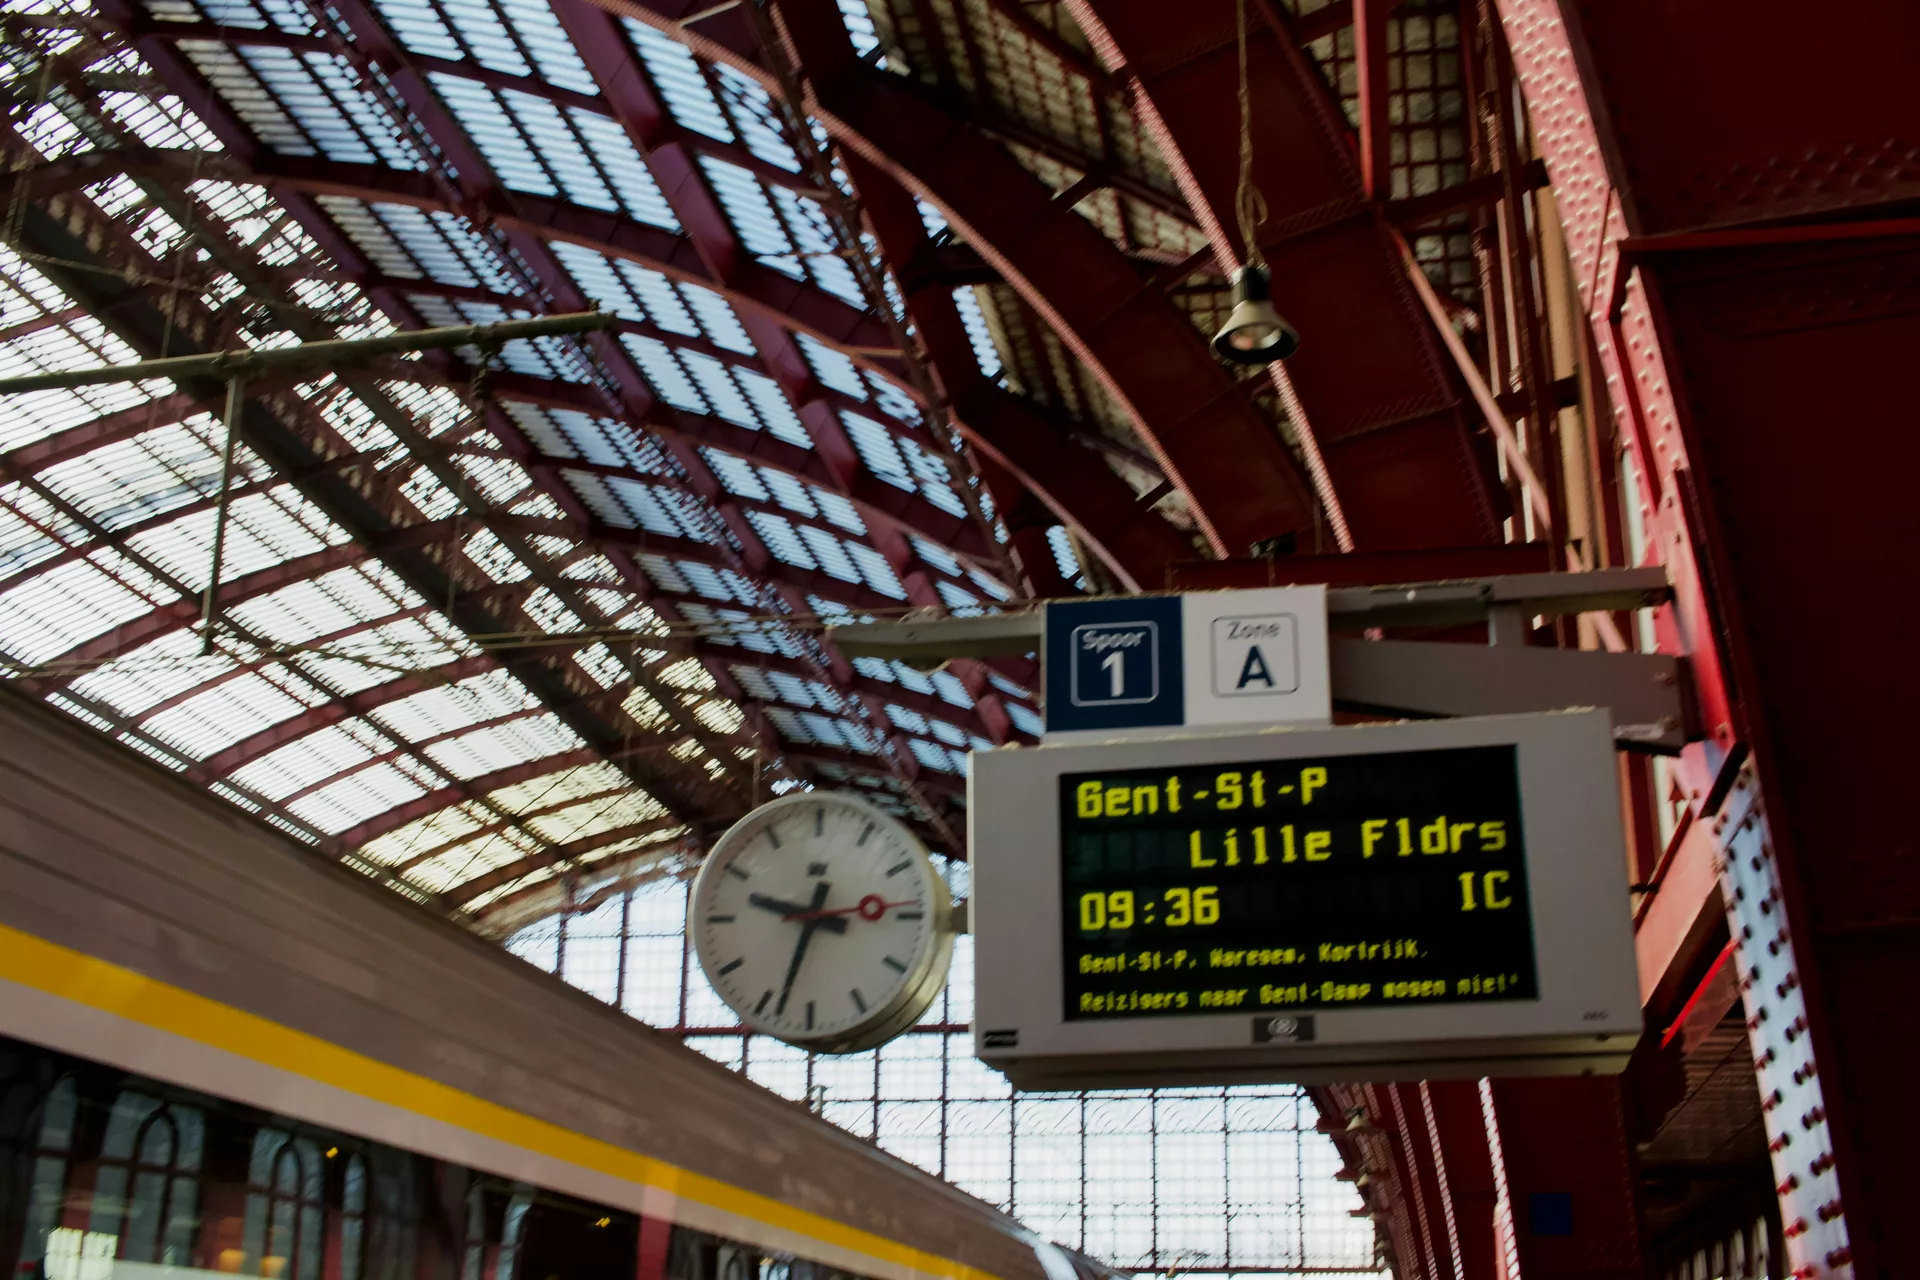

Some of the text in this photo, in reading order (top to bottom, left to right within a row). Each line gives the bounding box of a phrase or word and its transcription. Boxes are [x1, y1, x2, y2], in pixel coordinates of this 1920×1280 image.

[1081, 630, 1146, 653] Spoor
[1226, 620, 1281, 641] Zone
[1101, 651, 1125, 697] 1
[1236, 645, 1275, 689] A
[1077, 767, 1327, 818] Gent-St-P
[1190, 816, 1505, 868] Lille Fldrs
[1080, 886, 1220, 930] 09:36
[1458, 871, 1511, 911] IC
[1200, 988, 1248, 1007] naar
